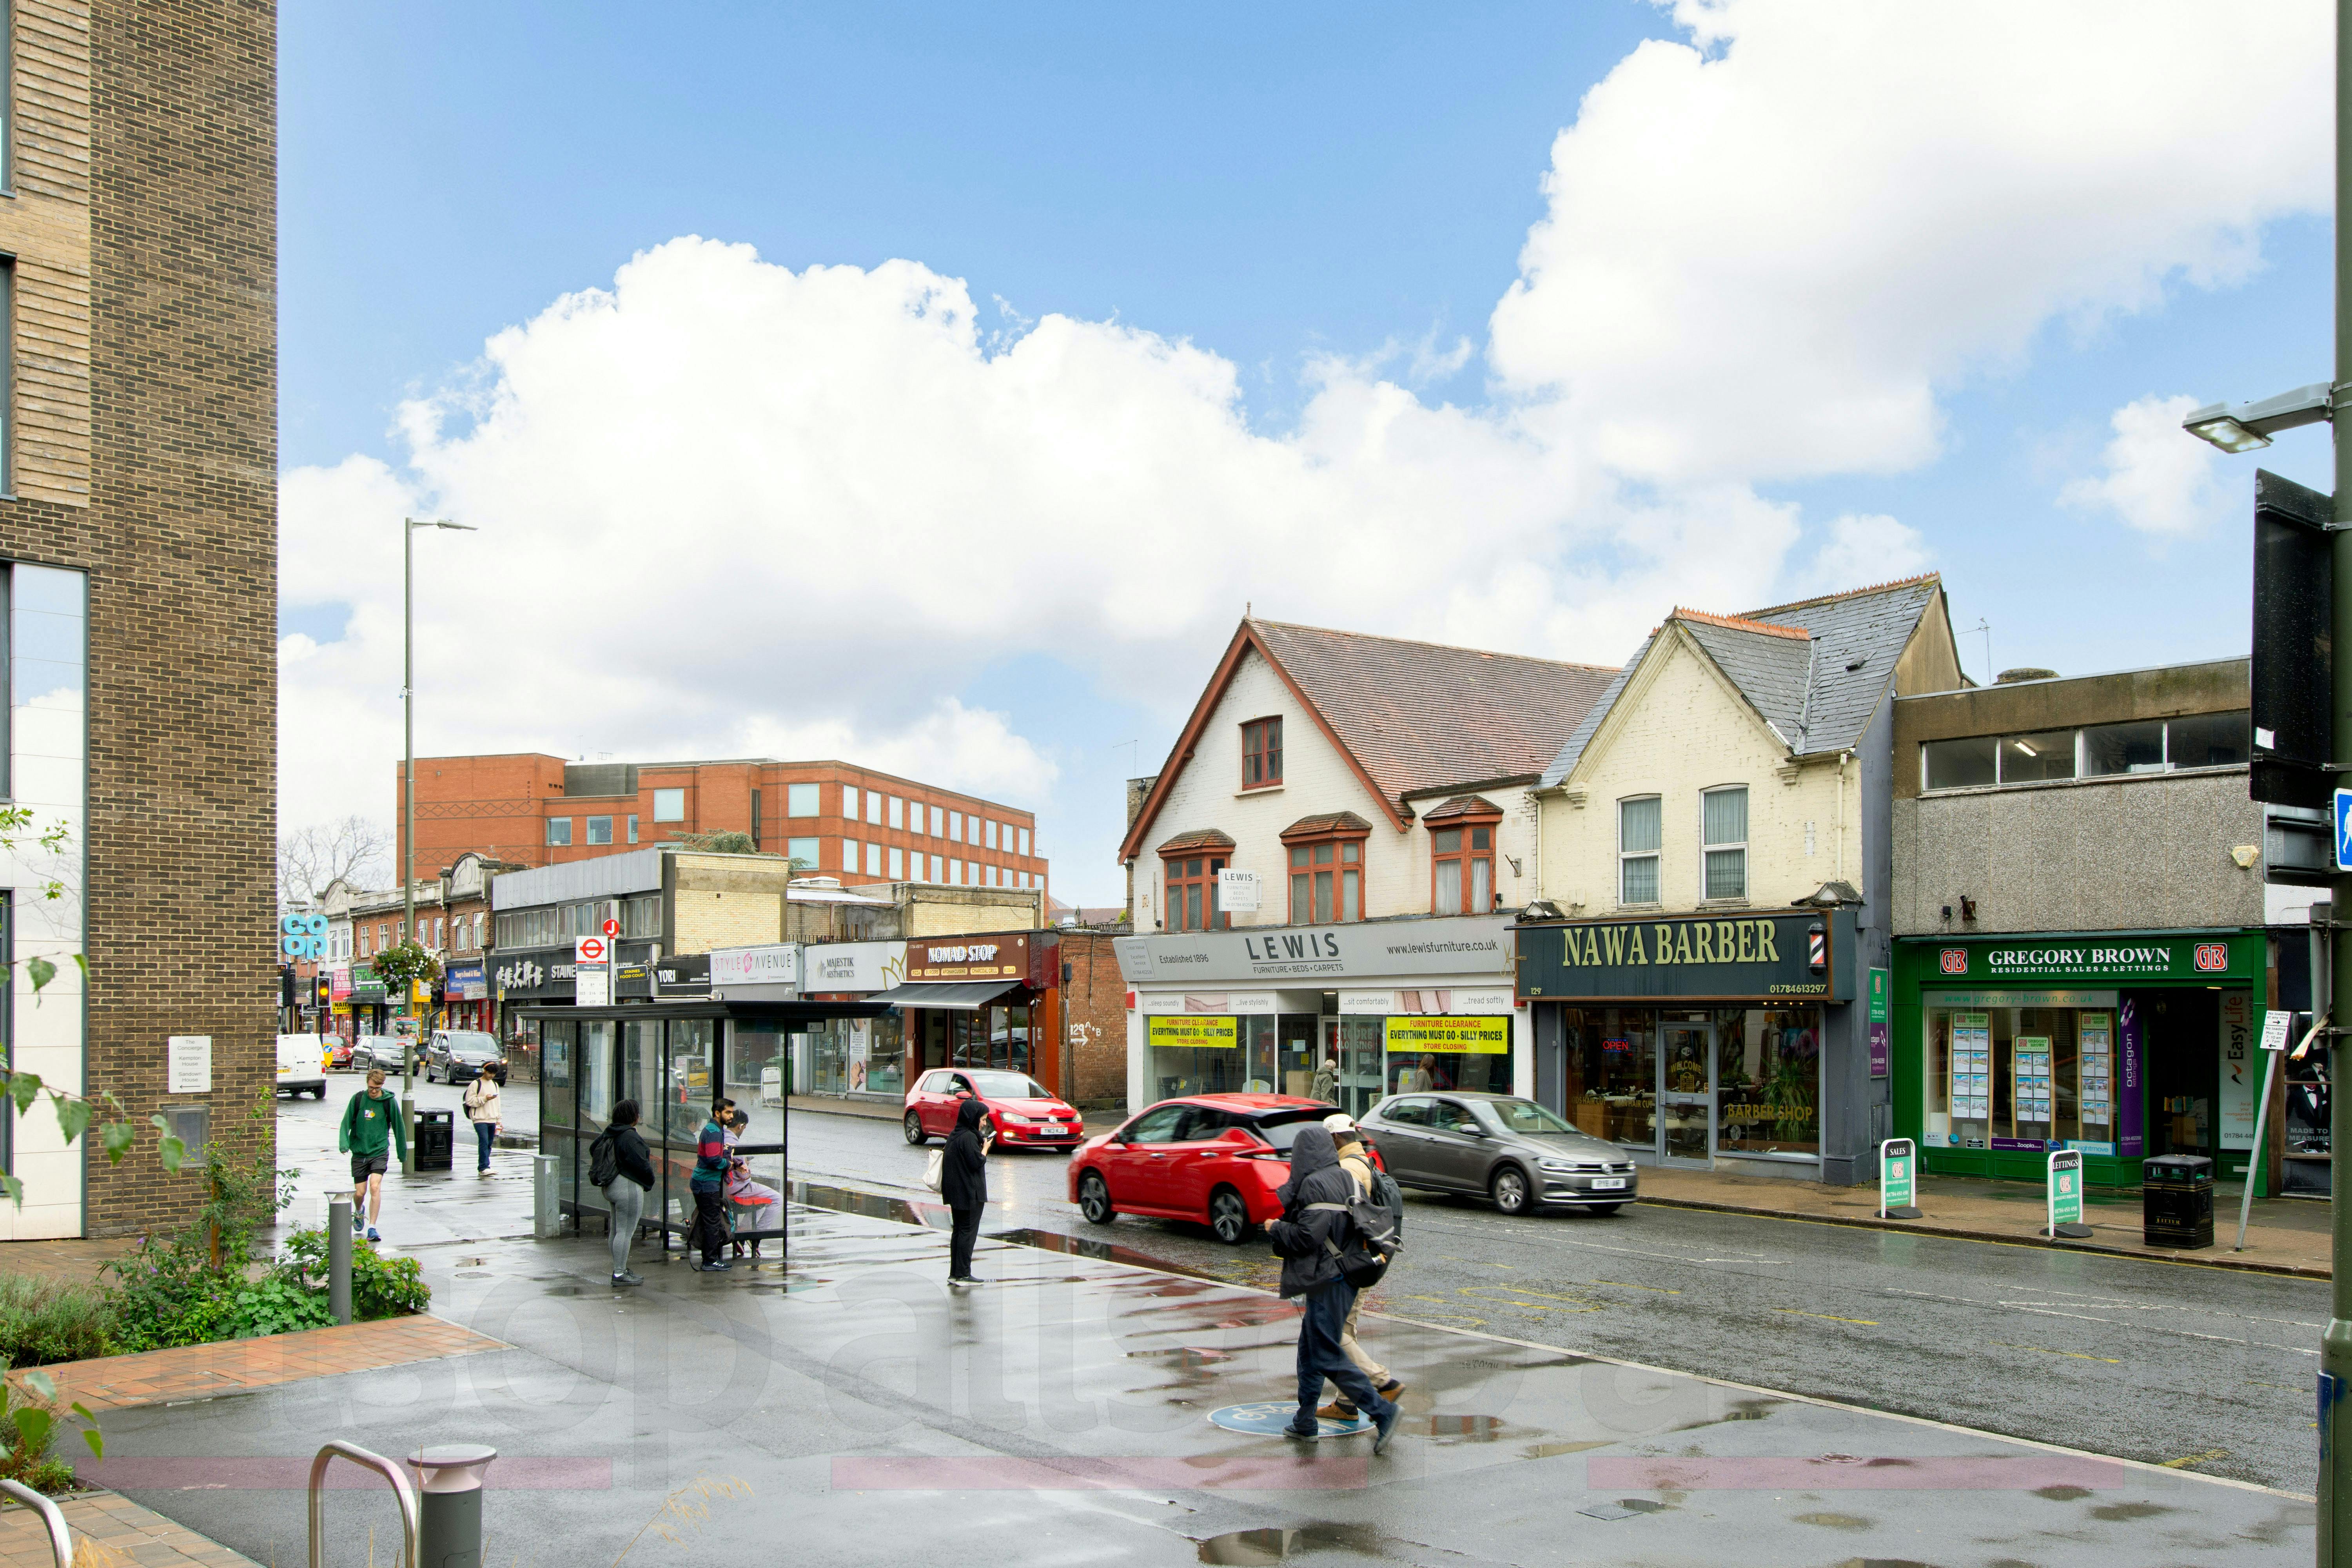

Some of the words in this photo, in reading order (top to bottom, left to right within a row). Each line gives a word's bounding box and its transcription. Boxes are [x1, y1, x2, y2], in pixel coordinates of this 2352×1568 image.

[608, 922, 615, 933] J
[1245, 933, 1339, 960] LEWIS
[1387, 939, 1498, 955] www.lewisfurniture.co.uk
[1563, 925, 1648, 966] NAWA
[1655, 920, 1780, 964] BARBER
[928, 946, 967, 963] NOMAD
[968, 945, 997, 962] STOP
[1159, 955, 1192, 963] Established
[1193, 954, 1209, 962] 1896
[1988, 949, 2087, 965] GREGORY
[2091, 947, 2171, 964] BROWN
[715, 957, 740, 971] STYLE
[755, 954, 791, 969] AVENUE
[826, 957, 854, 970] MAJESTIK
[455, 971, 464, 980] Tony's
[551, 965, 576, 978] STAINE
[658, 970, 676, 983] YORI
[1769, 984, 1827, 993] 01784613297
[1356, 998, 1388, 1007] comfortably
[1486, 997, 1504, 1005] softly
[1945, 993, 2093, 1005] wwwgregory-brown.co.uk
[1070, 1024, 1084, 1035] 129
[1203, 1028, 1215, 1036] SILLY
[1216, 1029, 1233, 1037] PRICES
[2225, 997, 2248, 1060] EasyLife
[1390, 1030, 1427, 1040] EVERYTHING
[1428, 1030, 1445, 1040] MUST
[1446, 1031, 1455, 1040] GO
[1461, 1031, 1477, 1040] SILLY
[1479, 1031, 1503, 1041] PRICES
[1602, 1041, 1628, 1050] OPEN
[2126, 1033, 2134, 1087] octagon
[1671, 1060, 1702, 1074] WELCOME
[1728, 1103, 1775, 1120] BARBER
[1778, 1105, 1813, 1121] SHOP
[2053, 1159, 2078, 1169] LETTINGS
